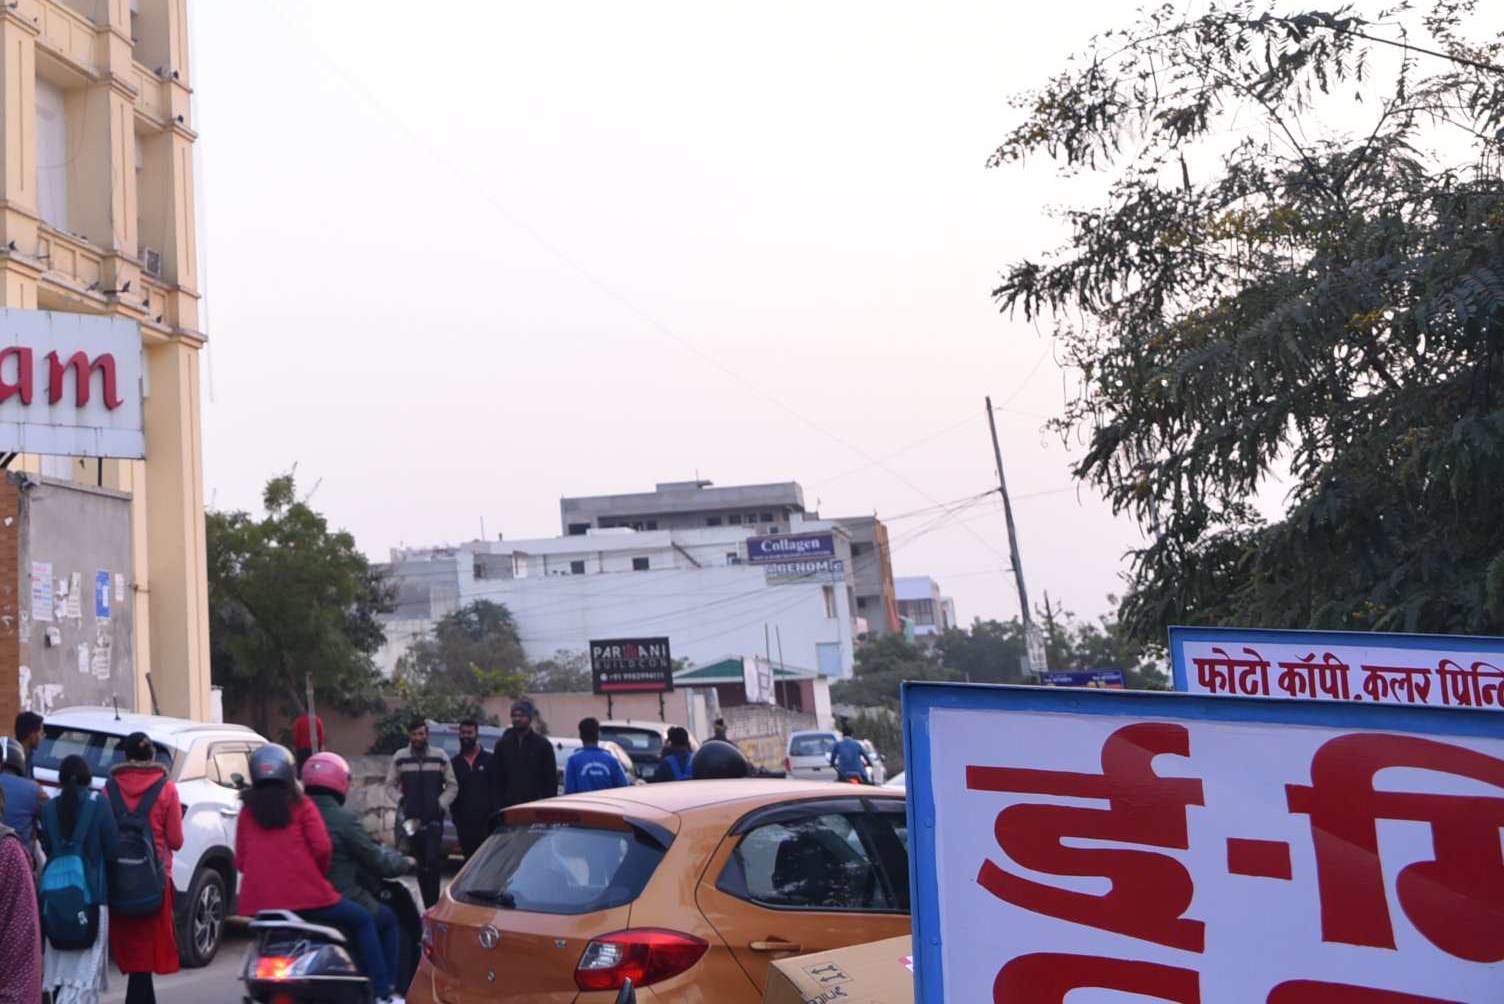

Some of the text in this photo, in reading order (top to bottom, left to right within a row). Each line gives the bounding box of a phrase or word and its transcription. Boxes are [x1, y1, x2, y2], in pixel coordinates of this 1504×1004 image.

[761, 538, 820, 553] Collagen
[1192, 648, 1271, 696] फोटो
[1361, 665, 1432, 704] कलर
